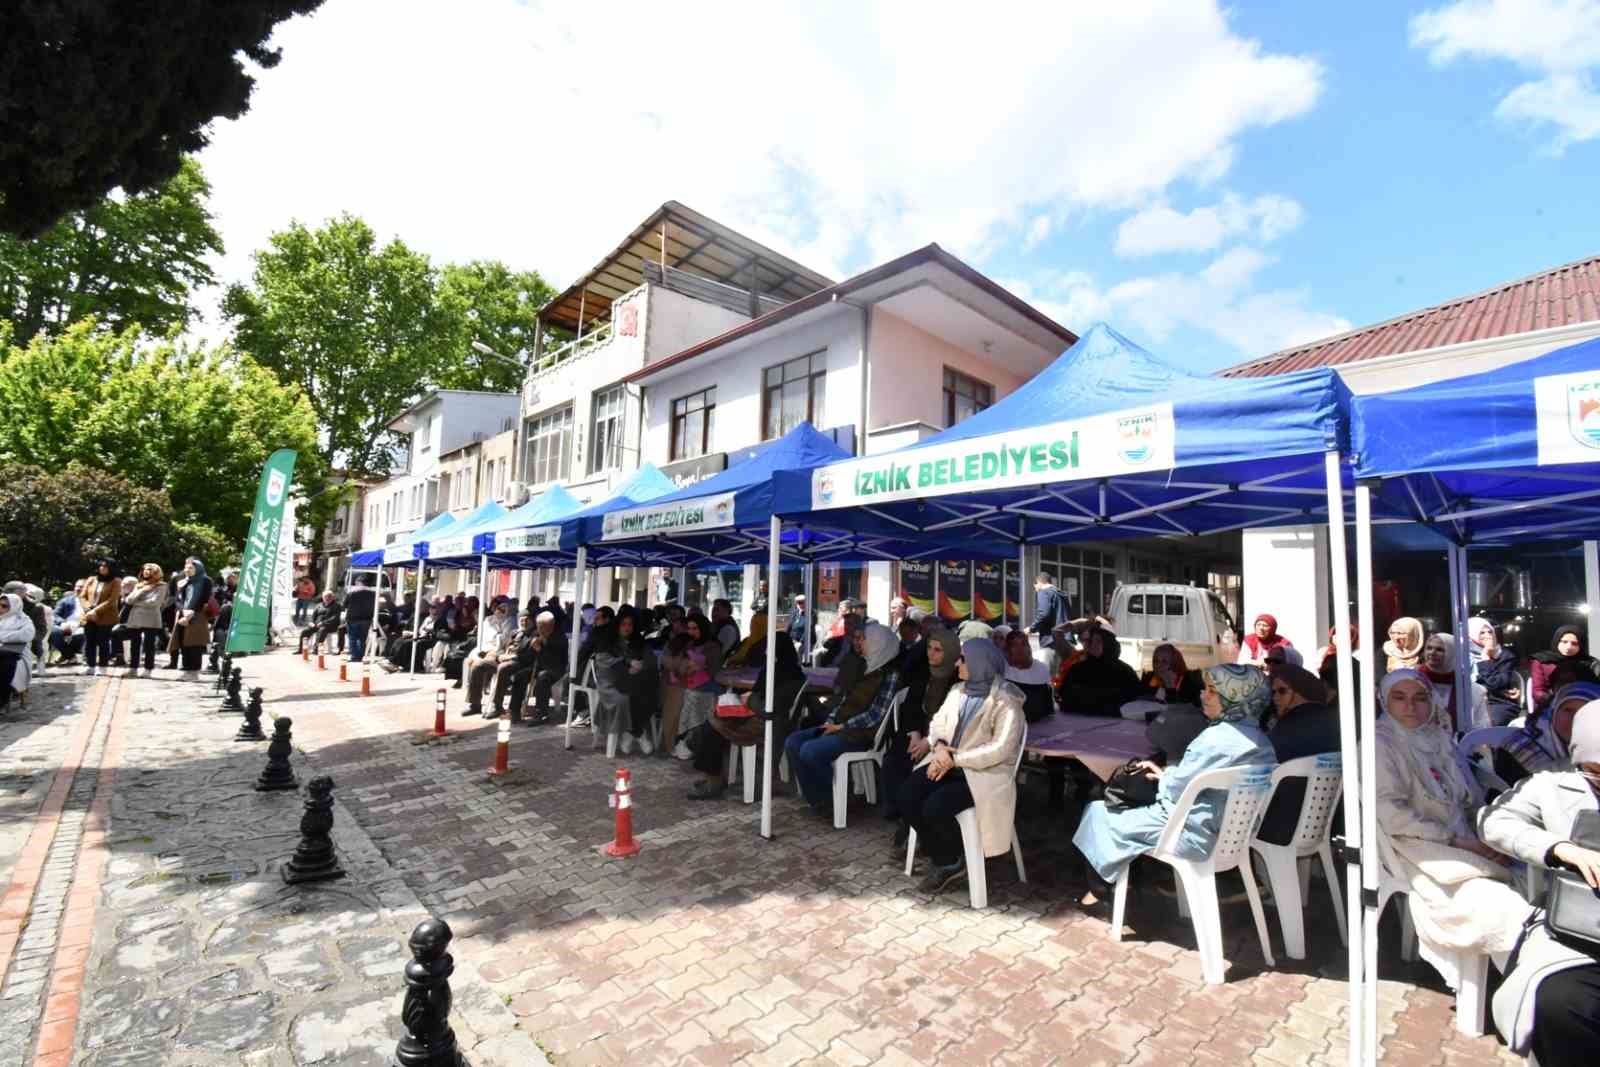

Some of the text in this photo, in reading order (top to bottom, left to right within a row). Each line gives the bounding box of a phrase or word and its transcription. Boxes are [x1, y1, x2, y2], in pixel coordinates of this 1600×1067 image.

[854, 430, 1079, 497] İZNİK BELEDİYESİ
[239, 512, 271, 608] İZNİK
[258, 518, 280, 609] BELEDİYESİ
[901, 561, 929, 573] Marshall
[940, 564, 967, 575] Marshall
